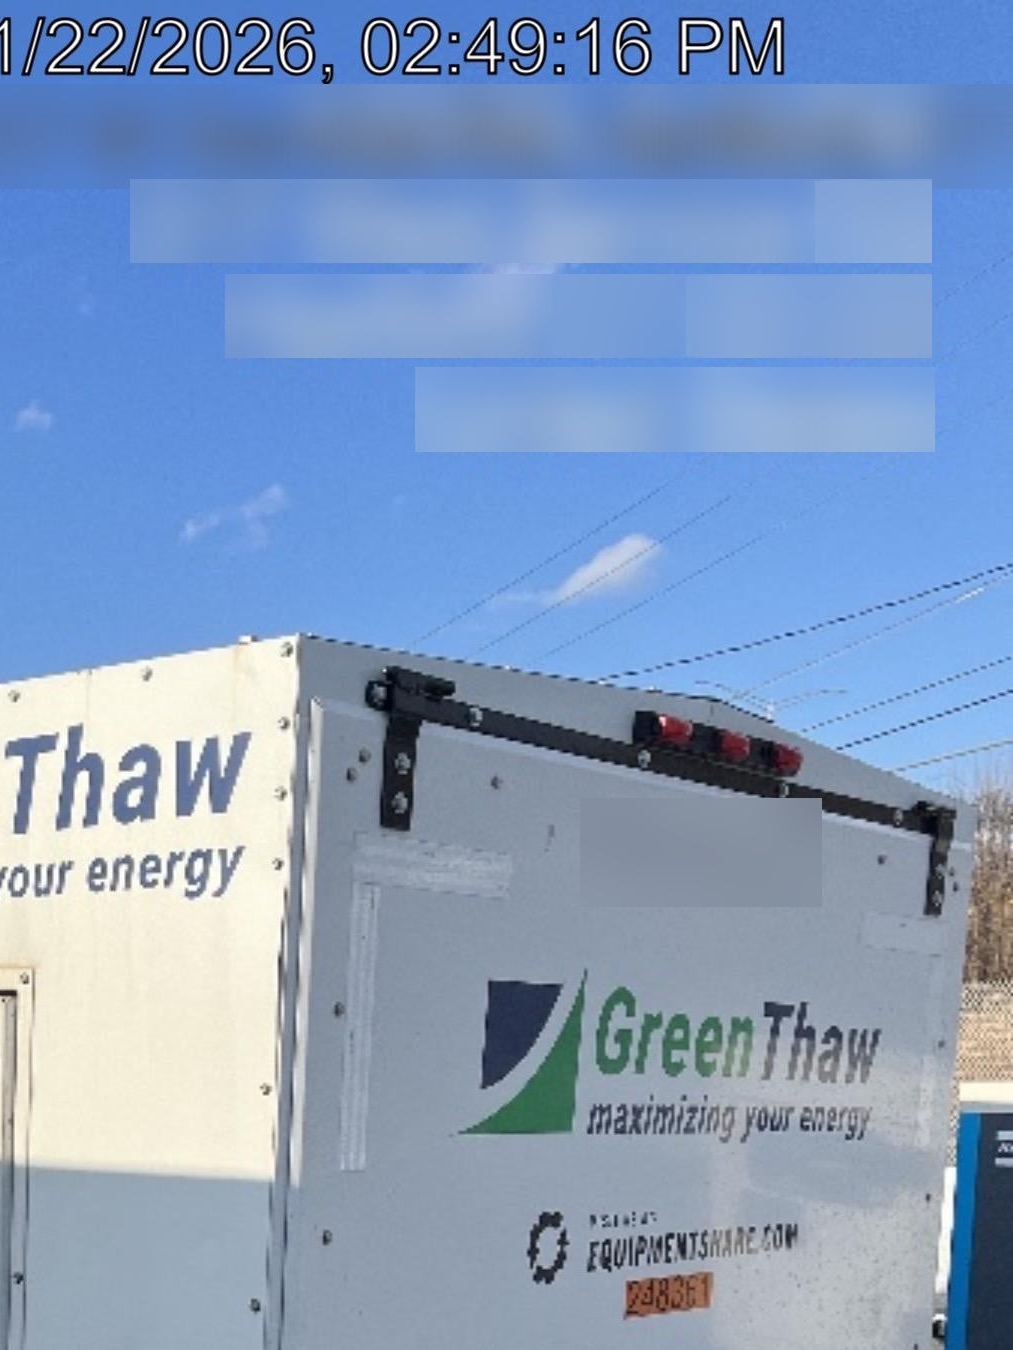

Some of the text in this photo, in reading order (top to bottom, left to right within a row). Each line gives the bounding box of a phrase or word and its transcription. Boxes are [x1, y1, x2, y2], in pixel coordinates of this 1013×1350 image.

[86, 843, 246, 900] energy
[586, 1096, 872, 1143] maximizing your energy
[586, 1223, 799, 1272] EQUIPMENTSHARE.COM
